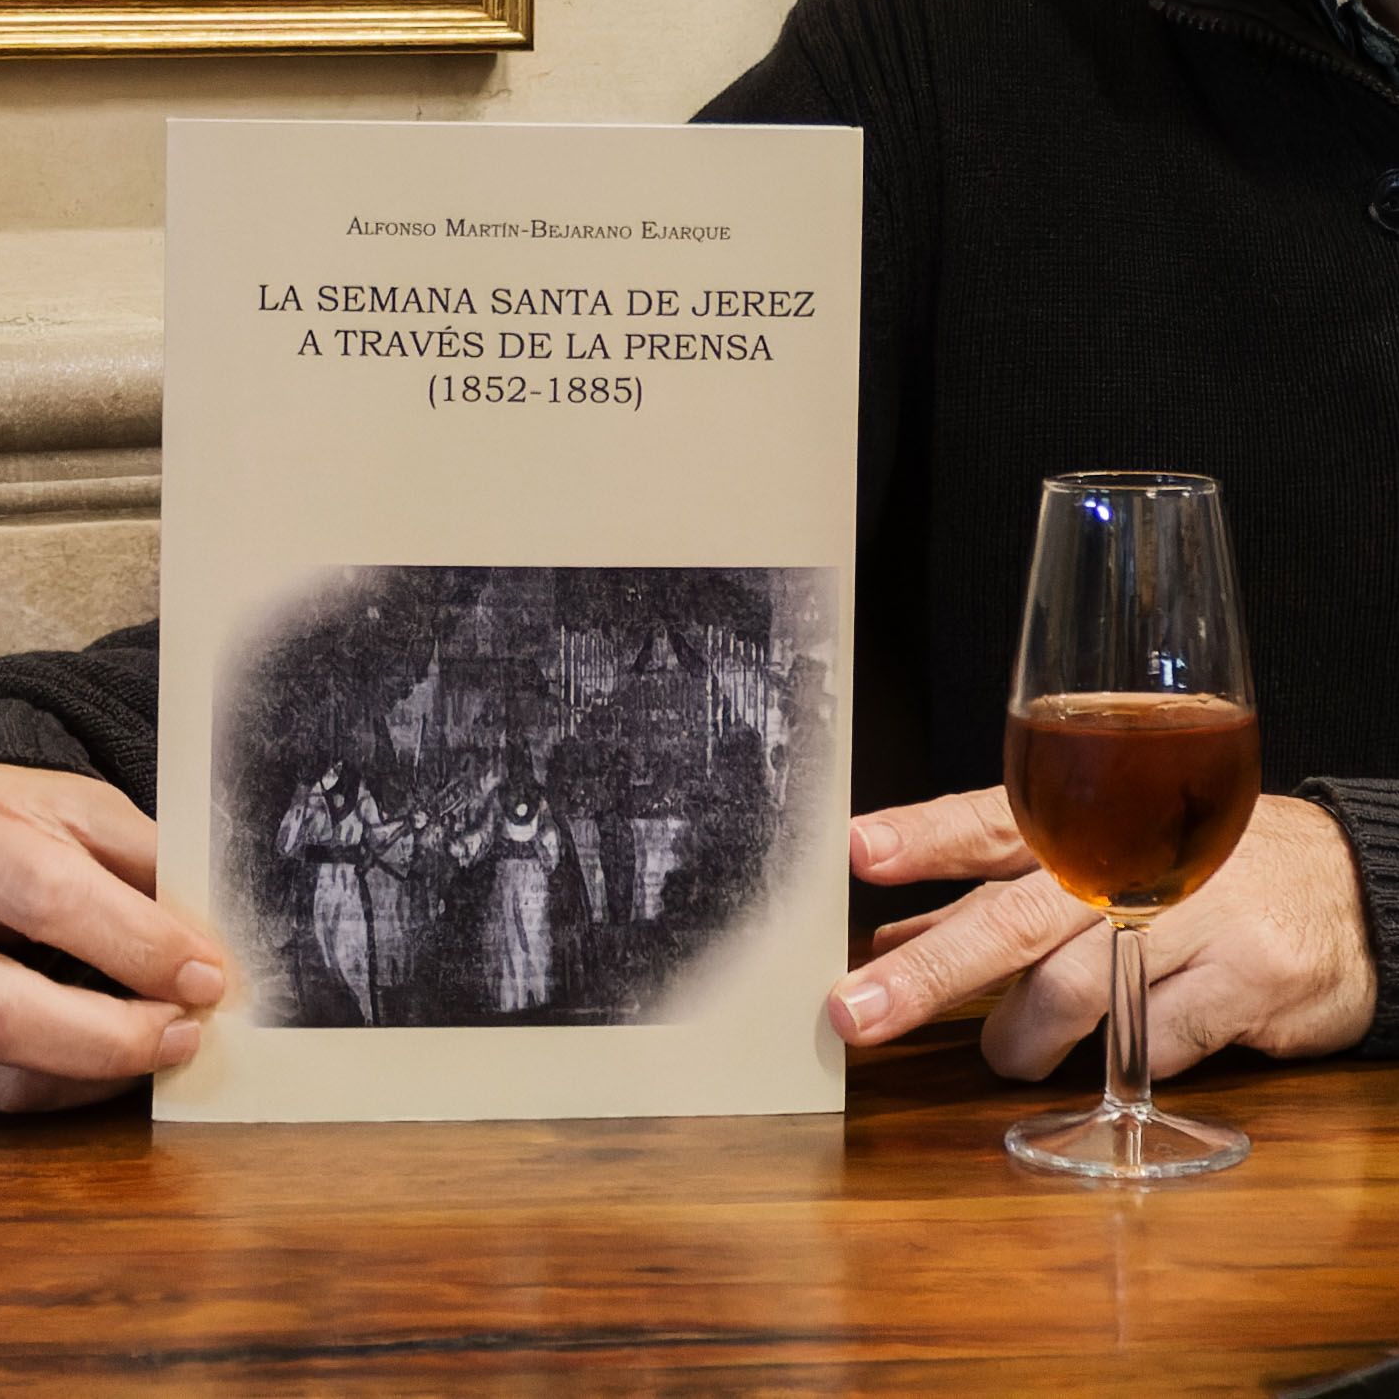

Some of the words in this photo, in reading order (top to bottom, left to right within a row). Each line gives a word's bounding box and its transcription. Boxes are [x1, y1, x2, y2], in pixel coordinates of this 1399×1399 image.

[258, 283, 304, 312] LA
[316, 284, 478, 316] SEMANA
[490, 287, 614, 318] SANTA
[626, 288, 680, 318] DE
[690, 289, 817, 319] JEREZ
[297, 328, 324, 357] A
[333, 325, 485, 360] TRAVÉS
[497, 331, 554, 361] DE
[565, 332, 612, 361] LA
[623, 332, 775, 362] PRENSA
[428, 374, 644, 413] (1852-1885)
